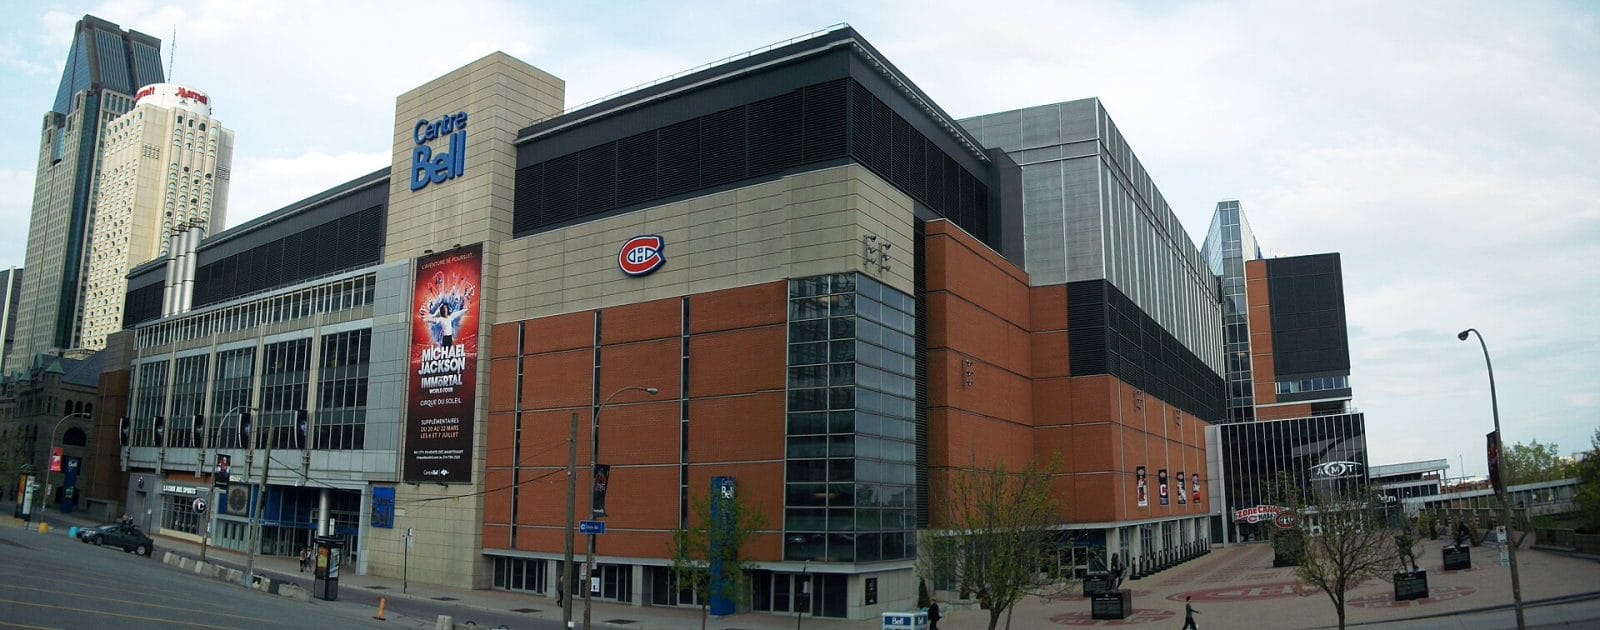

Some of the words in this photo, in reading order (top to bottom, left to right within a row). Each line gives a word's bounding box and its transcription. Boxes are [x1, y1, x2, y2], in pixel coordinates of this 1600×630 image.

[175, 87, 208, 104] Marriott
[414, 112, 468, 145] Centre
[411, 130, 467, 192] Bell
[422, 344, 466, 361] MICHAEL
[418, 357, 466, 375] JACKSON
[721, 486, 735, 499] Bell
[892, 617, 904, 625] Bell
